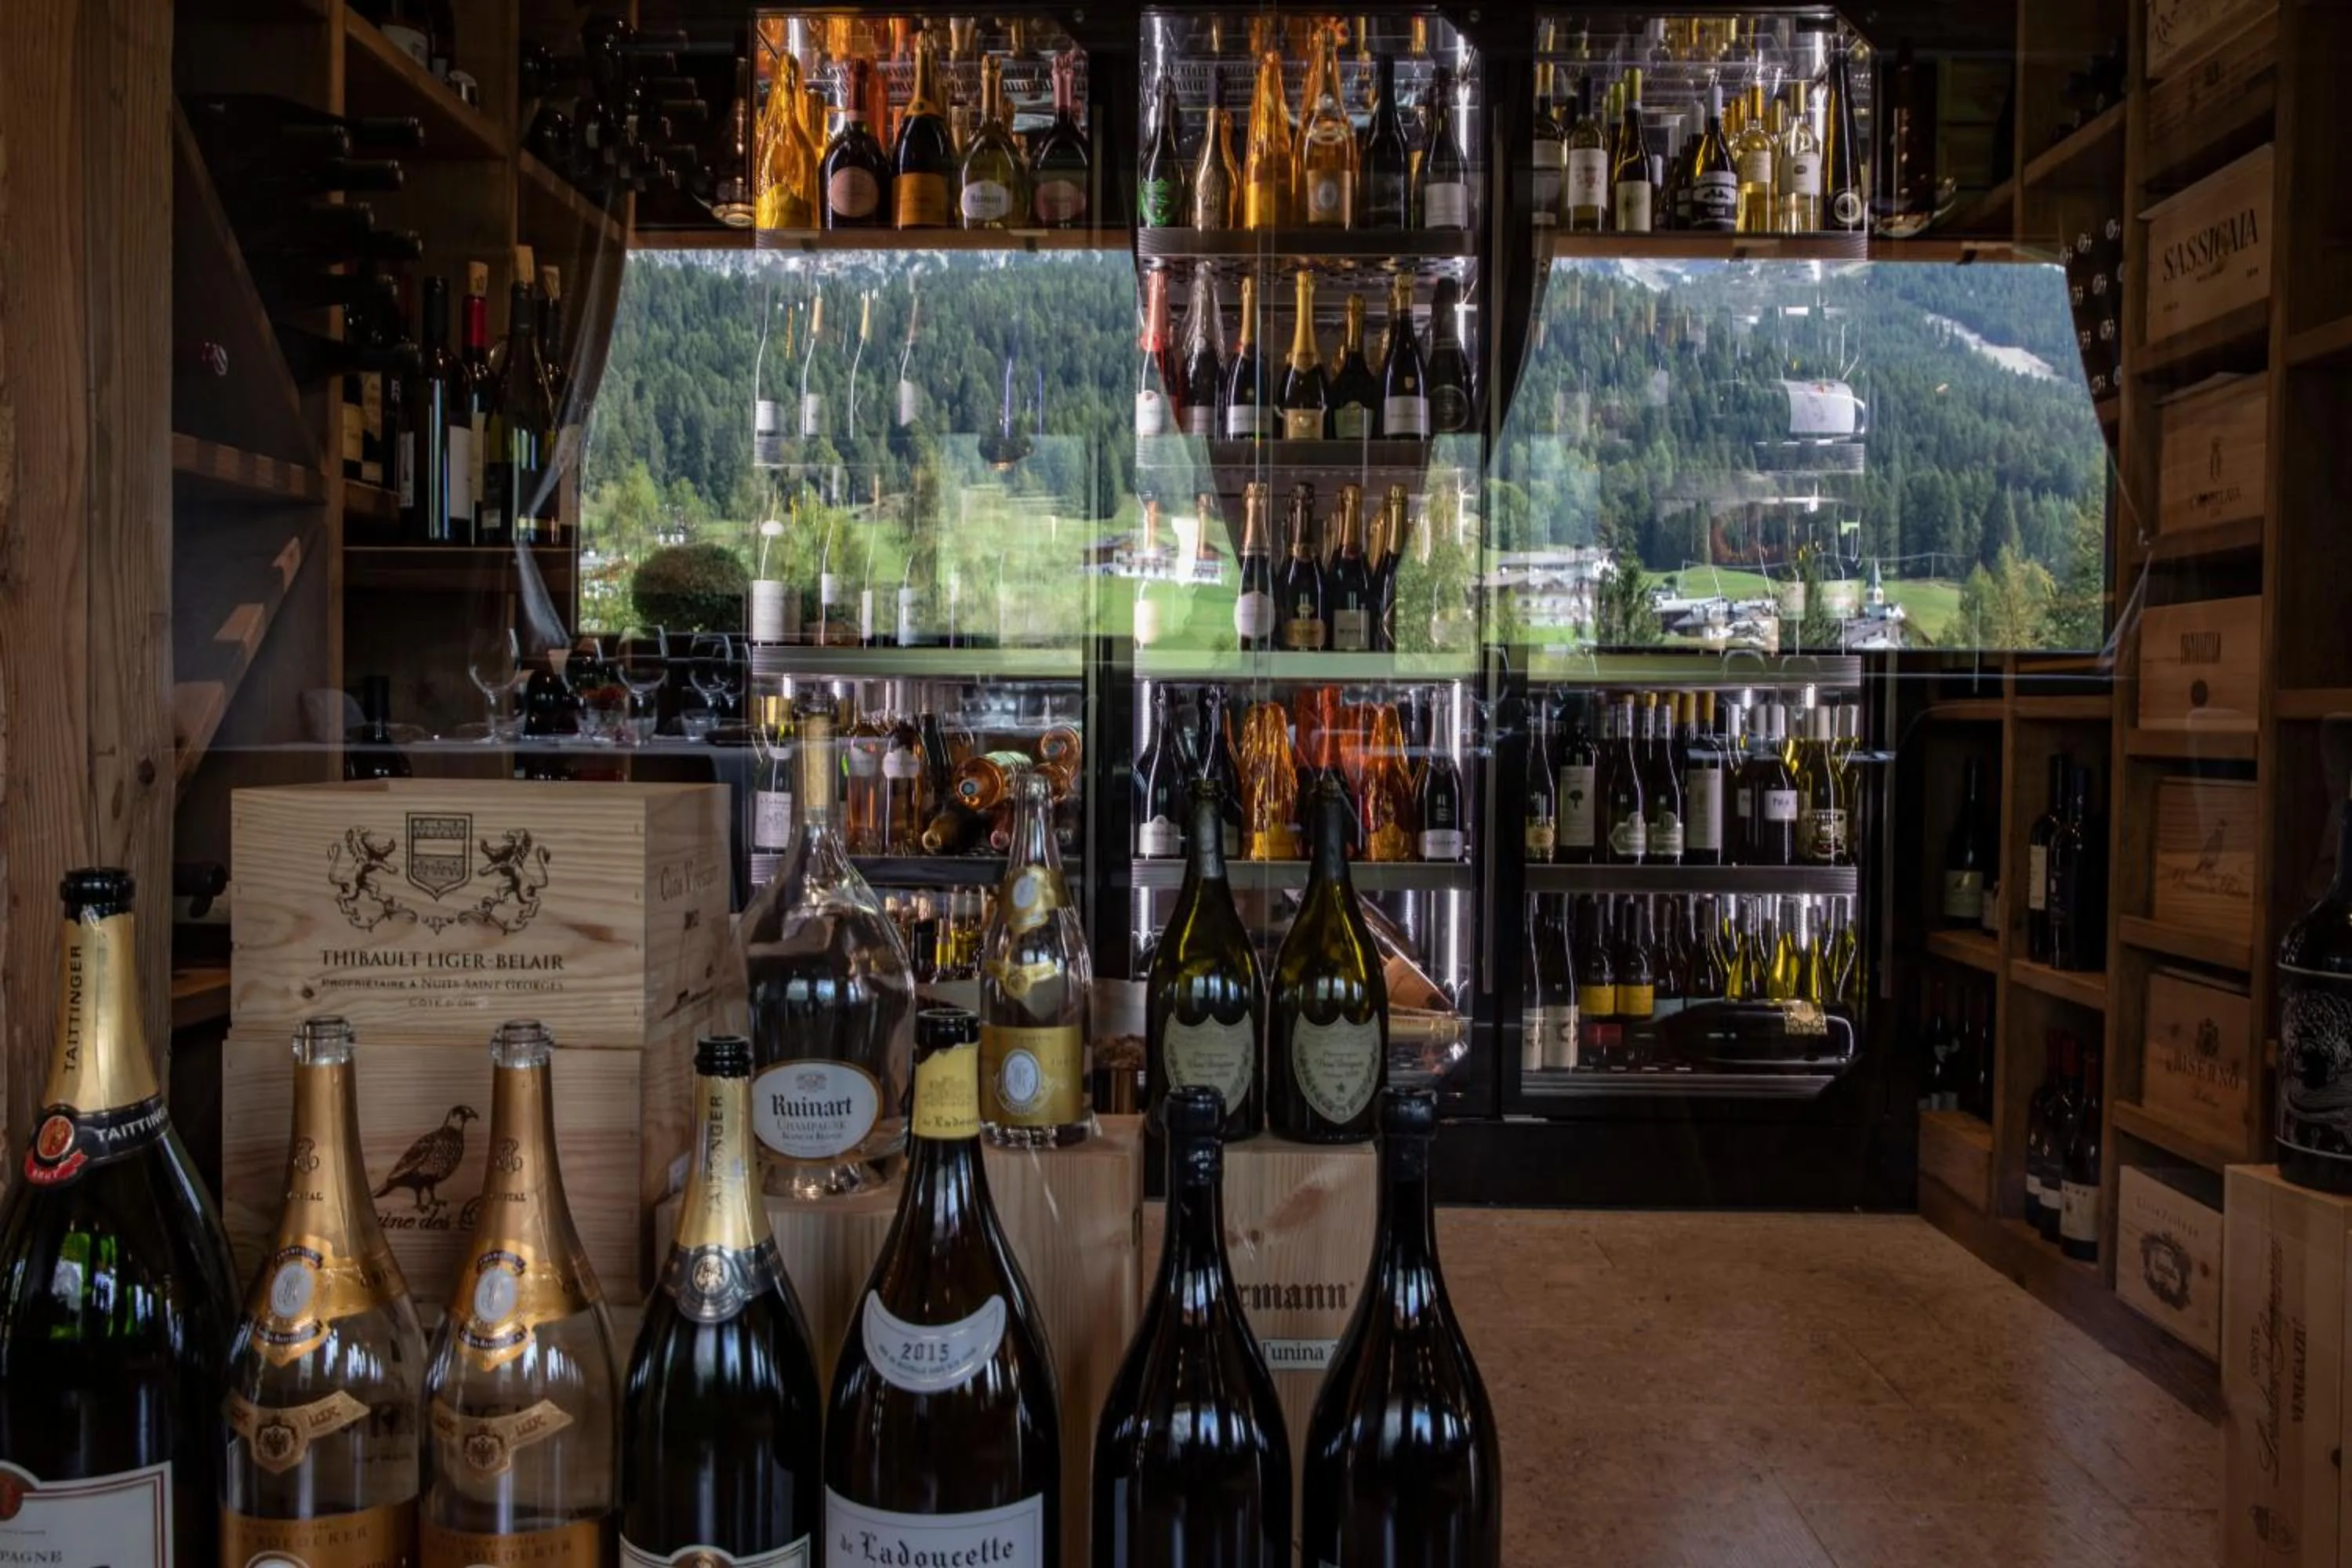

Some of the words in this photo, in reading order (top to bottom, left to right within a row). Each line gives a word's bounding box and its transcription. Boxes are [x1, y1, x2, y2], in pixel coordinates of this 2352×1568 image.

[2163, 209, 2259, 282] SASSICAIA
[320, 949, 419, 967] THIBAULT
[426, 952, 565, 971] LIGER-BELAIR
[63, 946, 82, 1073] TAITTINGER
[771, 1093, 854, 1118] Ruinart
[706, 1095, 724, 1214] TAITTNGER
[1238, 1283, 1348, 1311] rmann
[901, 1342, 950, 1362] 2015
[839, 1532, 855, 1555] de
[859, 1530, 1014, 1568] Ladoucette
